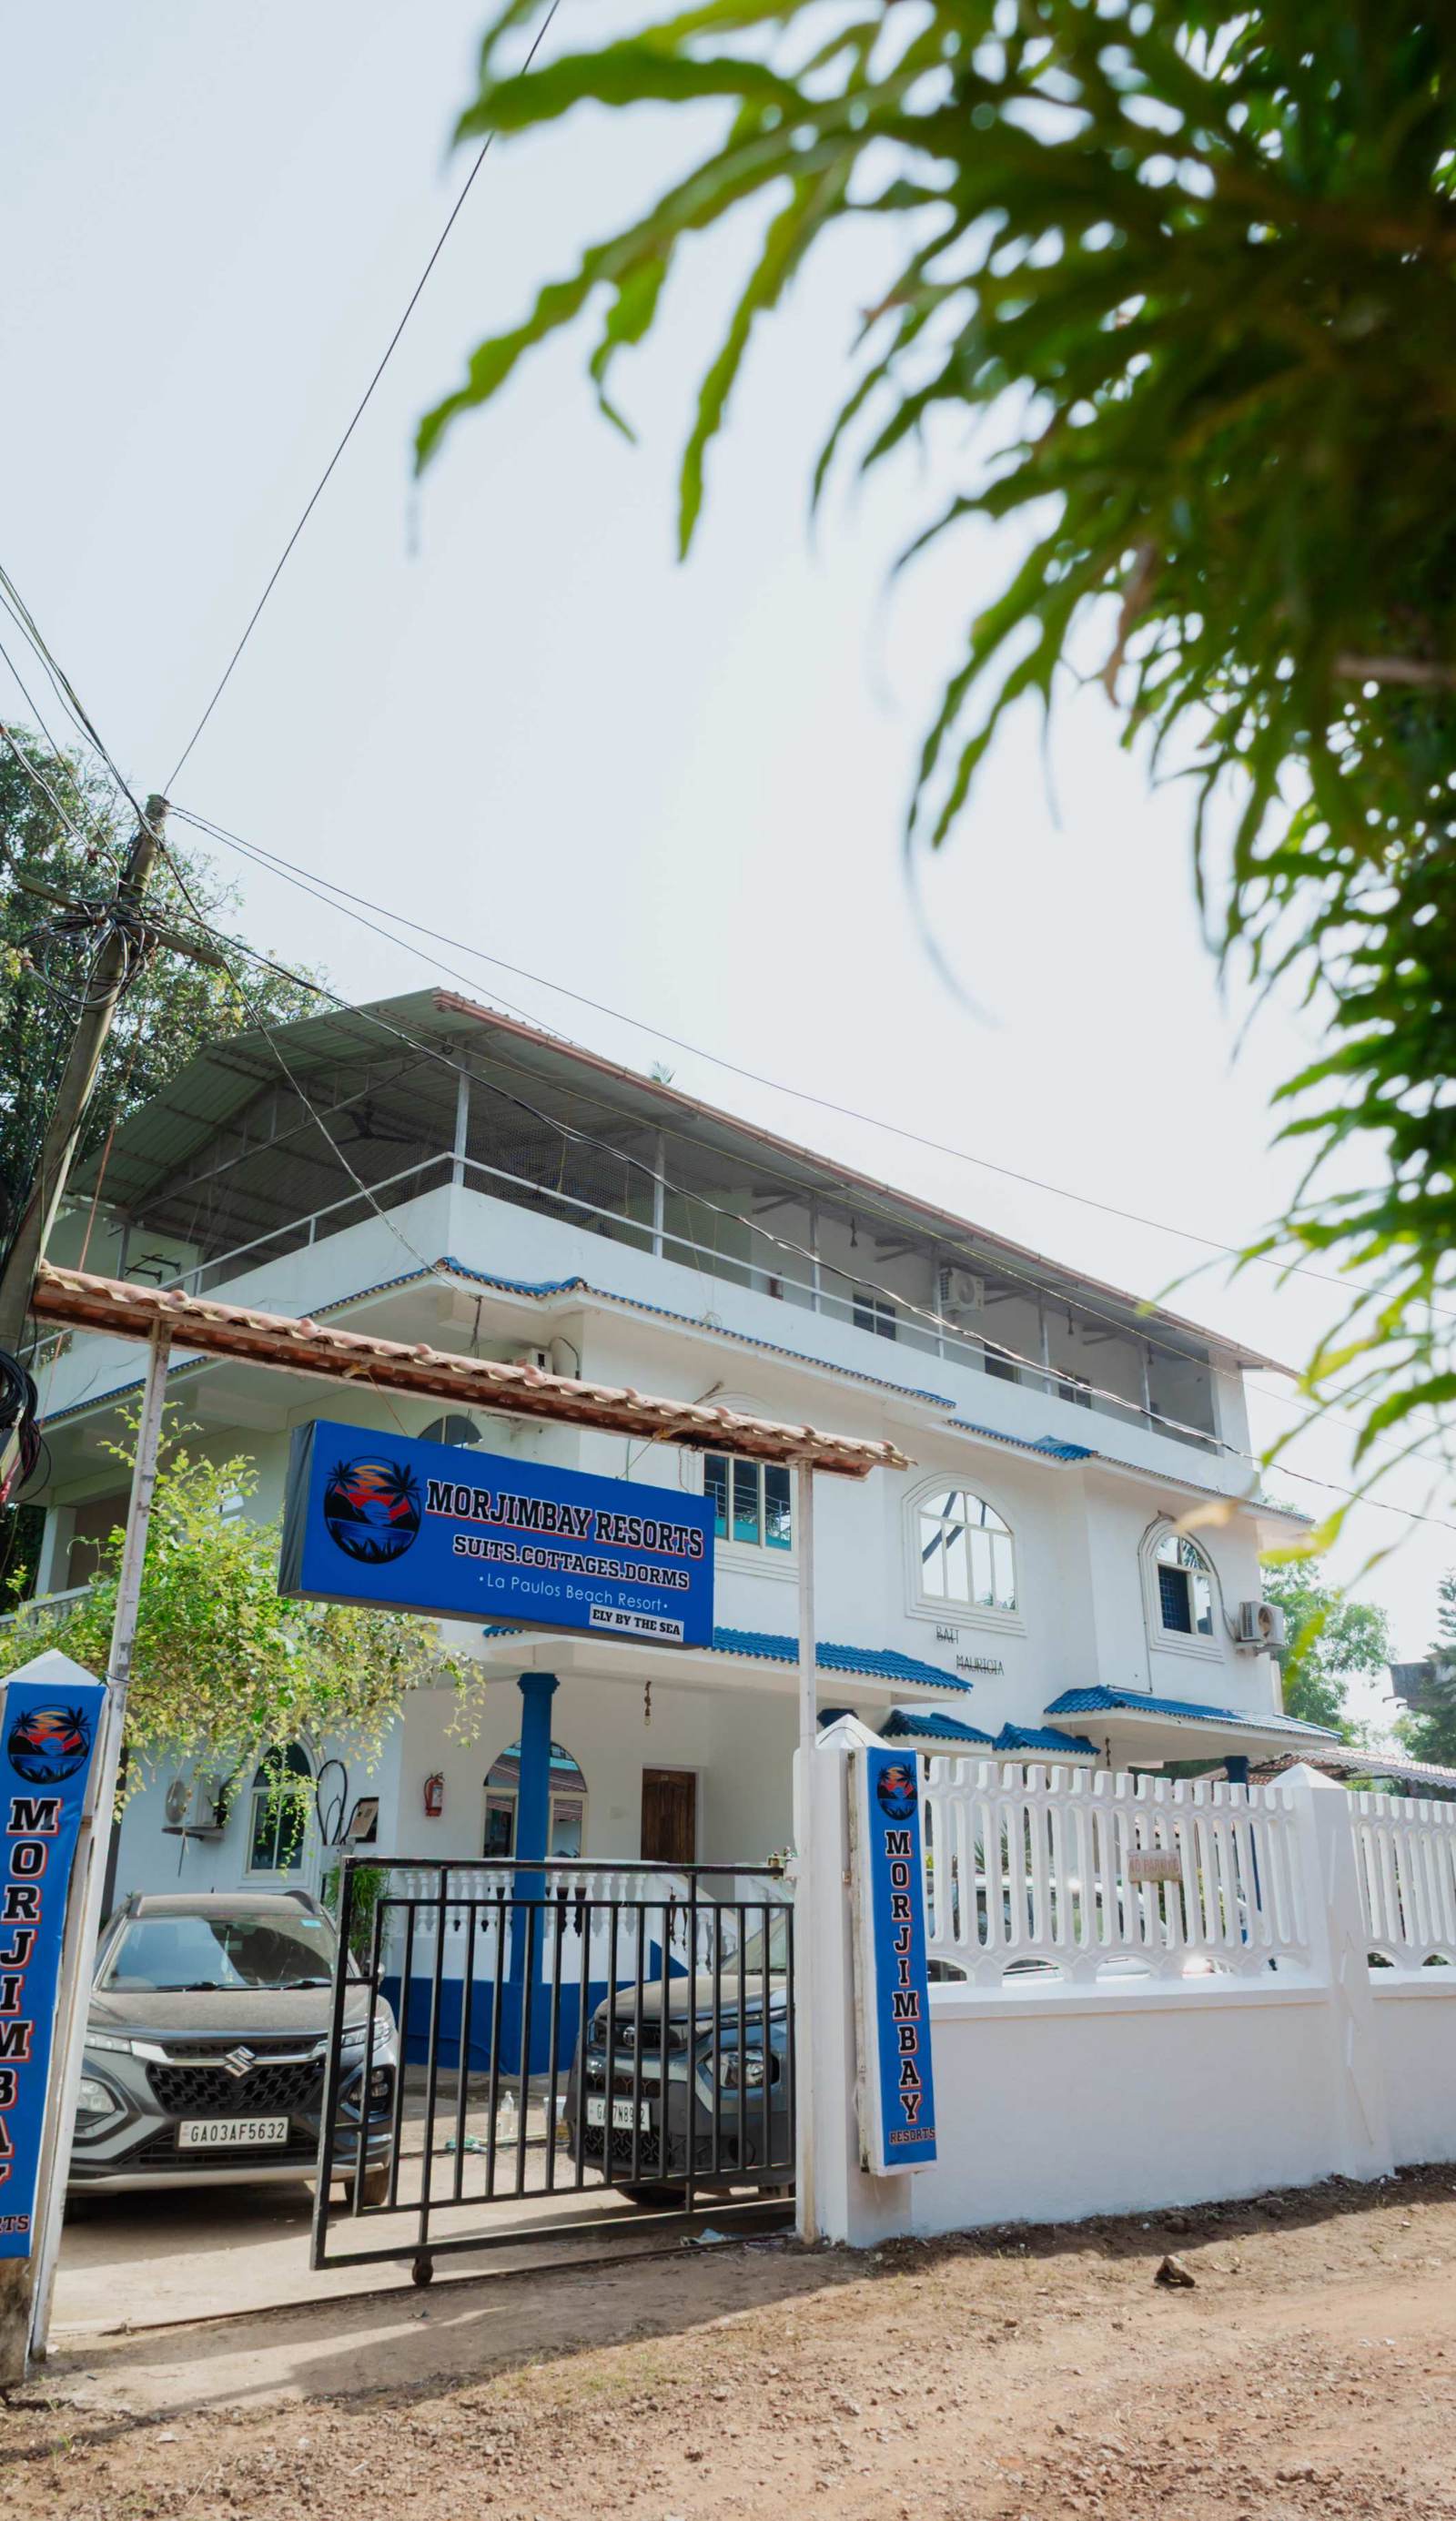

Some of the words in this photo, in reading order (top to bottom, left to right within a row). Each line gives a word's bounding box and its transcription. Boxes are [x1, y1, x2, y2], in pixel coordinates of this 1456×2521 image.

[425, 1478, 592, 1540] MORJIMBAY
[594, 1510, 704, 1559] RESORTS
[453, 1534, 690, 1591] SUITS.COTTAGES.DORMS
[487, 1573, 505, 1589] La
[511, 1575, 561, 1599] Paulos
[566, 1584, 612, 1605] Beach
[618, 1592, 662, 1612] Resort
[592, 1608, 613, 1623] ELY
[615, 1614, 632, 1626] BY
[634, 1616, 657, 1631] THE
[659, 1622, 681, 1635] SEA
[884, 1828, 923, 2125] MORJIMBAY
[190, 2122, 285, 2142] GA03AF5632
[889, 2127, 936, 2145] RESORTS
